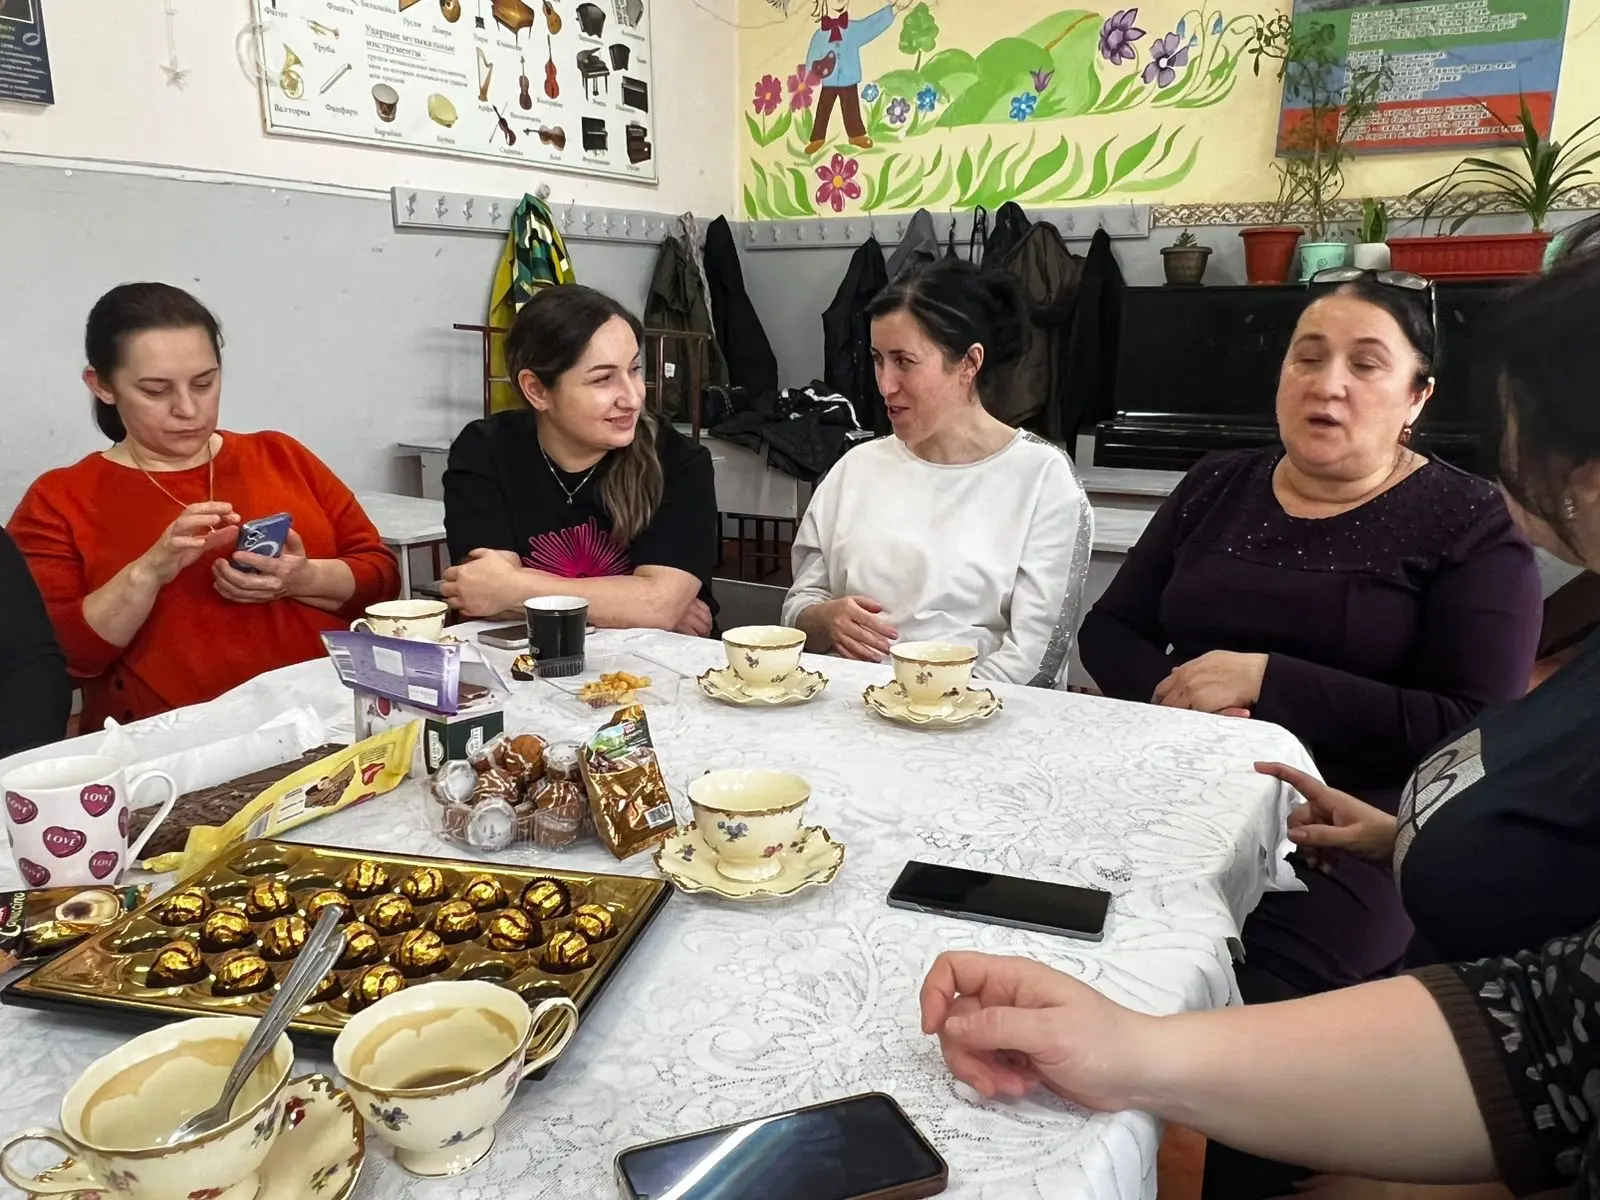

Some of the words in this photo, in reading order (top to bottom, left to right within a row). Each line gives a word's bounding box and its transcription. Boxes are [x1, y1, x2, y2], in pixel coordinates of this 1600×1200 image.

[365, 24, 400, 40] Ударные
[402, 35, 455, 52] музыкальные
[313, 42, 336, 54] Труба
[274, 103, 311, 117] Валторна
[83, 792, 110, 803] LOVE
[7, 796, 29, 815] LOVE
[46, 833, 77, 847] LOVE
[92, 858, 113, 868] LOVE
